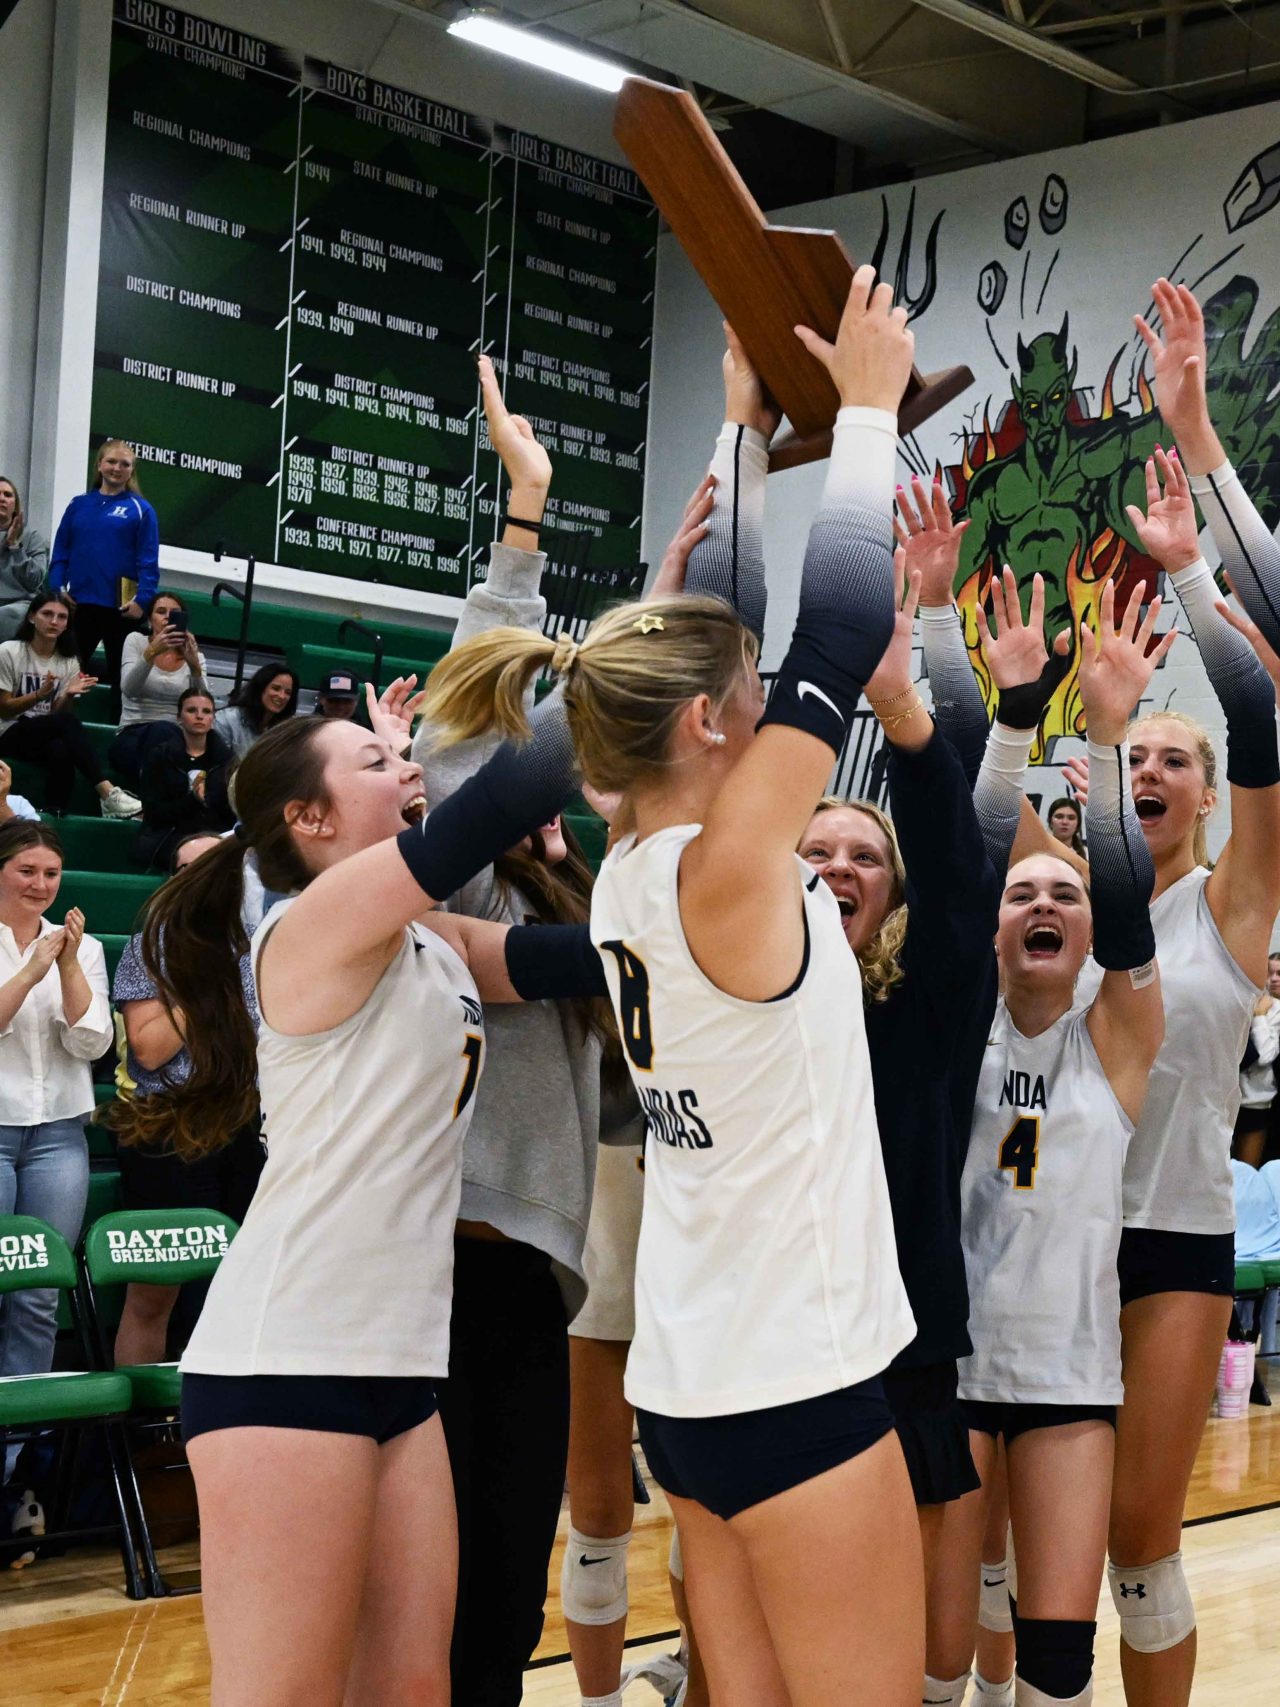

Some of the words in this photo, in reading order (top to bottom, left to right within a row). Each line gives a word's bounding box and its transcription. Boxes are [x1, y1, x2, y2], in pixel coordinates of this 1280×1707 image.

[125, 0, 176, 34] GIRLS
[183, 18, 266, 66] BOWLING
[147, 34, 180, 57] STATE
[184, 43, 246, 80] CHAMPIONS
[327, 66, 366, 100] BOYS
[373, 83, 470, 138] BASKETBALL
[133, 110, 184, 141] REGIONAL
[189, 129, 250, 161] CHAMPIONS
[356, 106, 384, 129] STATE
[387, 116, 442, 147] CHAMPIONS
[305, 161, 330, 183] 1944
[353, 160, 381, 182] STATE
[386, 171, 422, 195] RUNNER
[425, 184, 438, 198] UP
[556, 147, 640, 196] BASKETBALL
[130, 193, 181, 221] REGIONAL
[186, 209, 228, 236] RUNNER
[231, 224, 246, 238] UP
[536, 211, 561, 230] STATE
[565, 220, 597, 241] RUNNER
[600, 231, 611, 244] UP
[340, 229, 384, 255] REGIONAL
[389, 244, 443, 272] CHAMPIONS
[362, 252, 387, 272] 1944
[526, 255, 565, 279] REGIONAL
[569, 268, 616, 294] CHAMPIONS
[126, 275, 175, 301] DISTRICT
[179, 289, 241, 318] CHAMPIONS
[329, 315, 354, 336] 1940
[338, 301, 382, 326] REGIONAL
[386, 315, 423, 337] RUNNER
[426, 326, 438, 340] UP
[524, 303, 563, 326] REGIONAL
[567, 315, 599, 335] RUNNER
[602, 325, 613, 339] UP
[123, 357, 172, 382] DISTRICT
[176, 370, 218, 394] RUNNER
[222, 382, 236, 397] UP
[523, 349, 560, 372] DISTRICT
[563, 361, 611, 385] CHAMPIONS
[334, 373, 377, 396] DISTRICT
[380, 385, 434, 410] CHAMPIONS
[446, 417, 469, 436] 1968
[521, 414, 558, 433] STRICT
[560, 423, 593, 440] RUNNER
[595, 431, 606, 445] UP
[181, 453, 242, 479] CHAMPIONS
[331, 446, 373, 467] DISTRICT
[377, 456, 414, 477] RUNNER
[417, 465, 430, 479] UP
[287, 485, 312, 504] 1970
[563, 501, 610, 523] CHAMPIONS
[316, 516, 377, 541] CONFERENCE
[381, 529, 435, 552] CHAMPIONS
[437, 557, 460, 574] 1996
[999, 1069, 1047, 1110] NDA
[998, 1114, 1040, 1190] 4
[106, 1224, 228, 1249] DAYTON
[110, 1242, 230, 1264] GREENDEVILS
